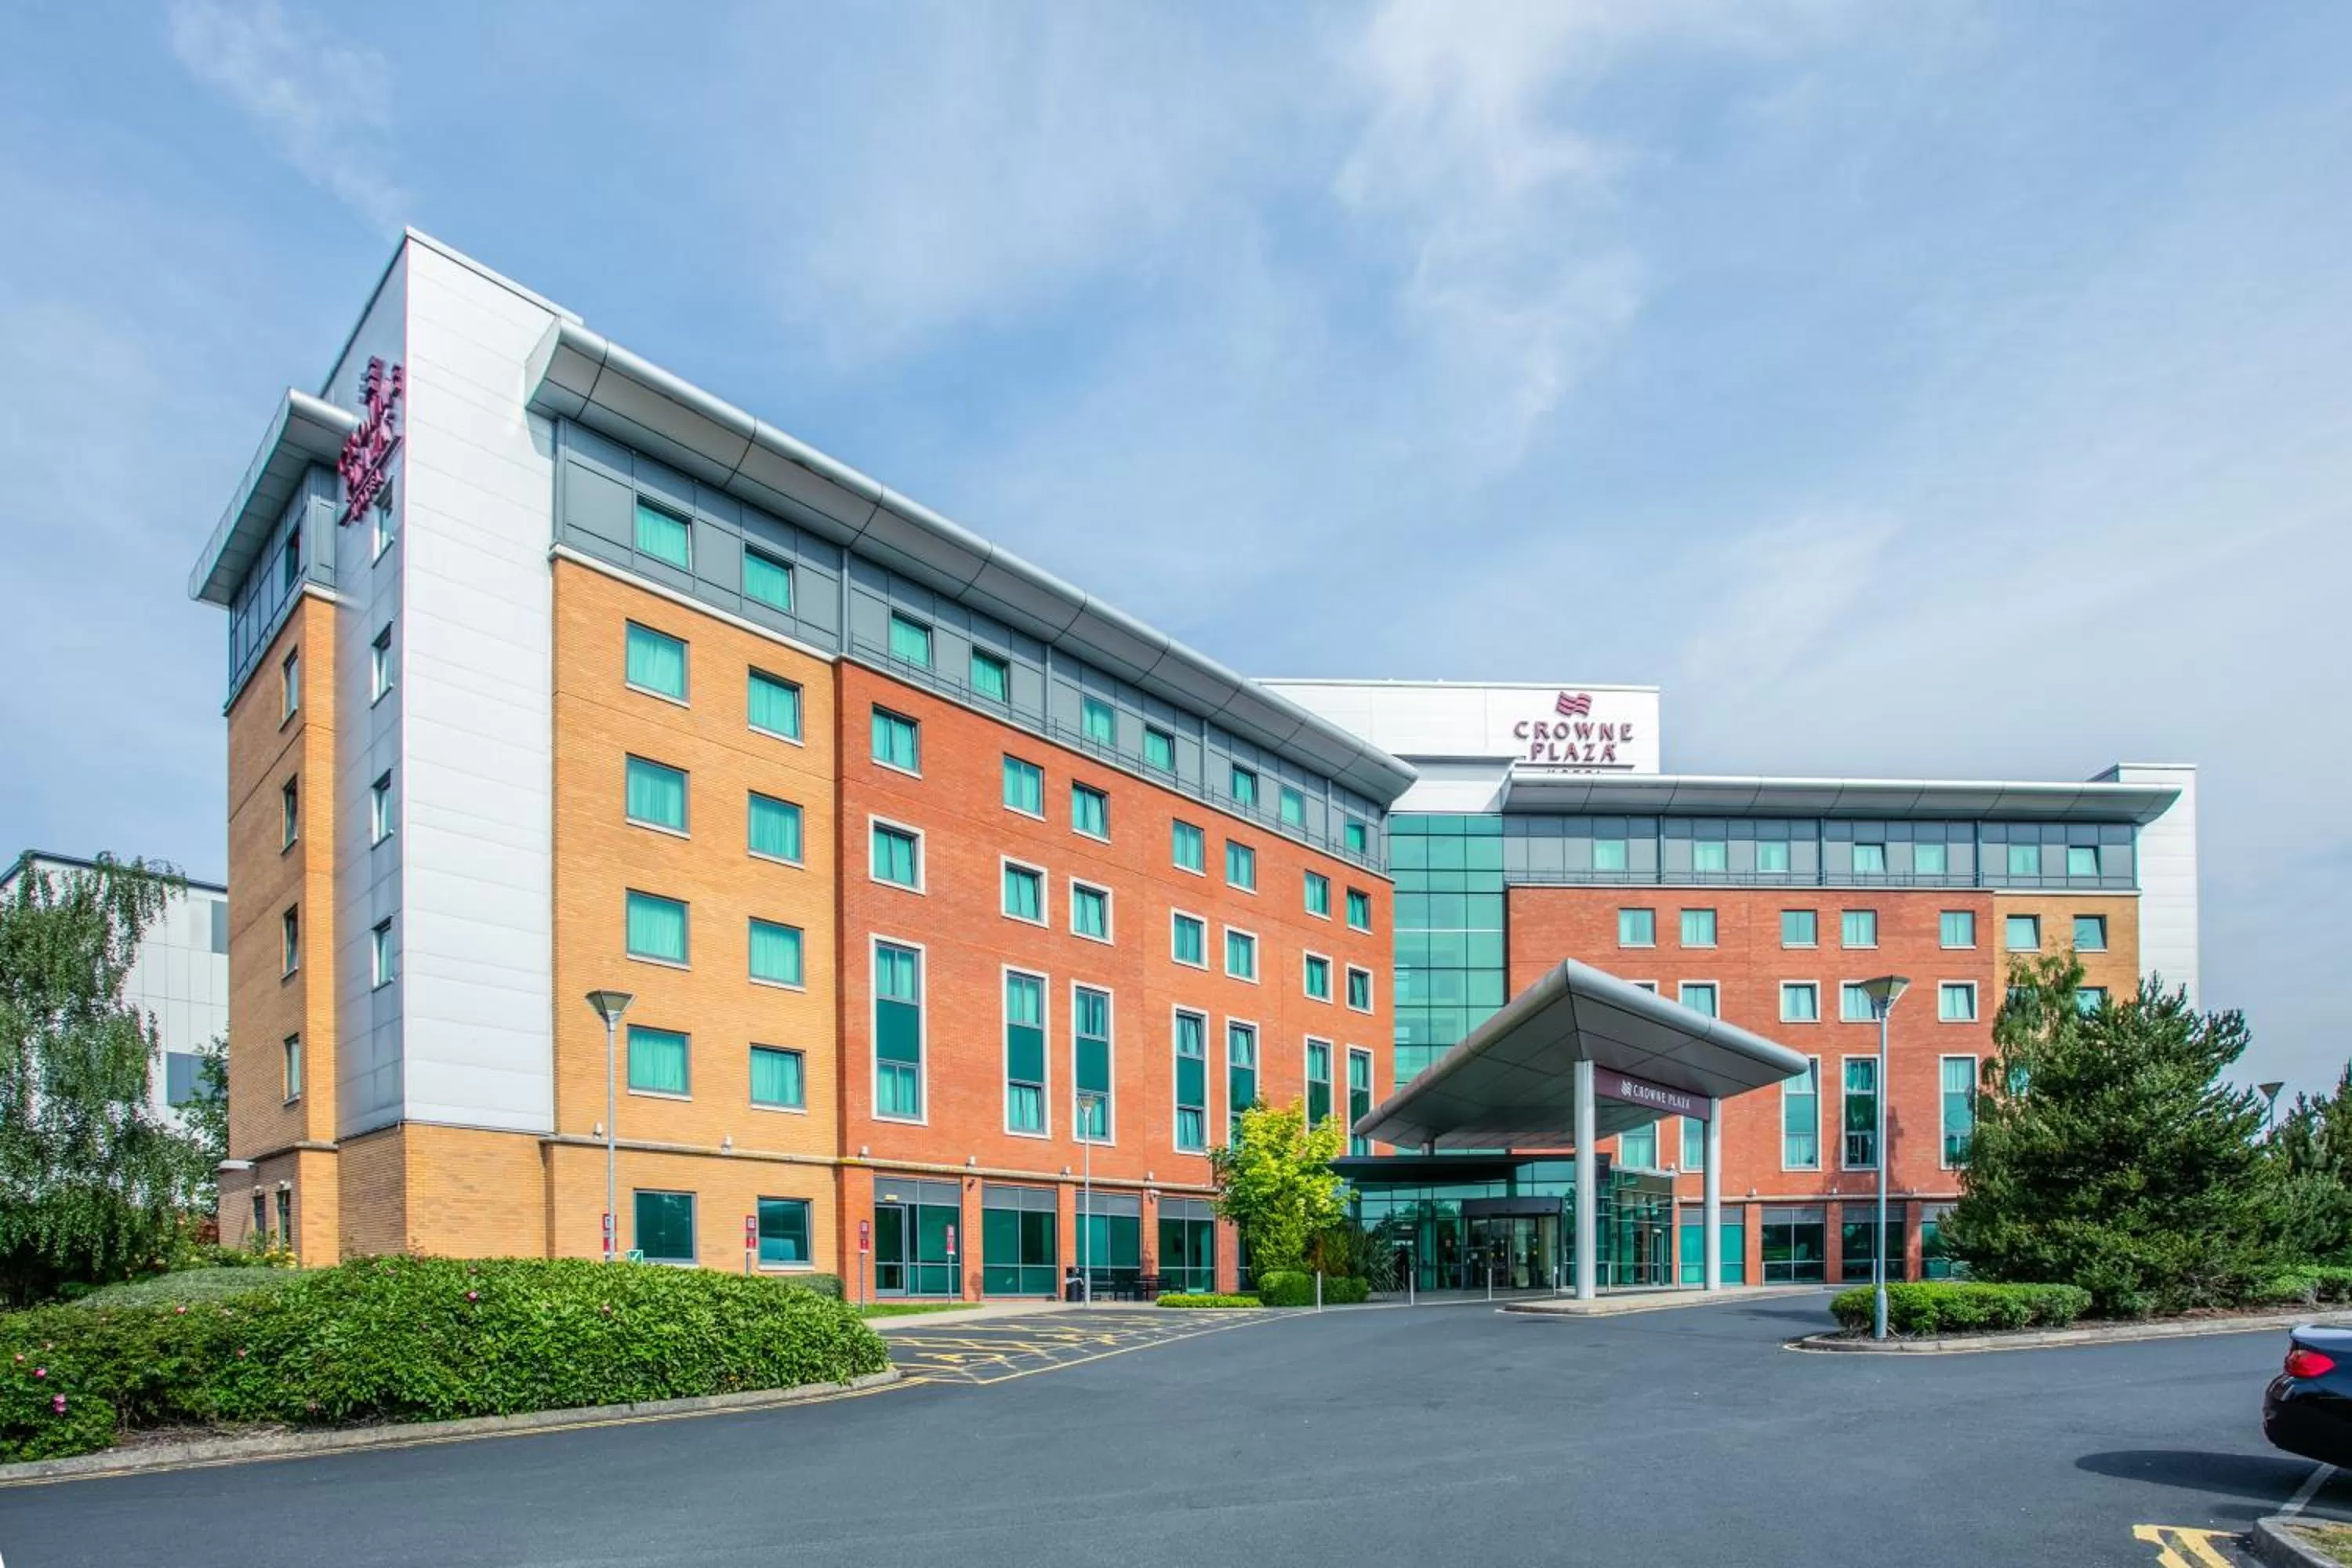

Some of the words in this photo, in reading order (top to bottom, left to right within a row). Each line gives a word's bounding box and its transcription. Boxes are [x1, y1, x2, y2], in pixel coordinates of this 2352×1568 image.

[1513, 720, 1633, 741] CROWNE
[1530, 742, 1616, 762] PLAZA
[1633, 1084, 1666, 1104] CROWNE
[1668, 1094, 1690, 1110] PLAZA
